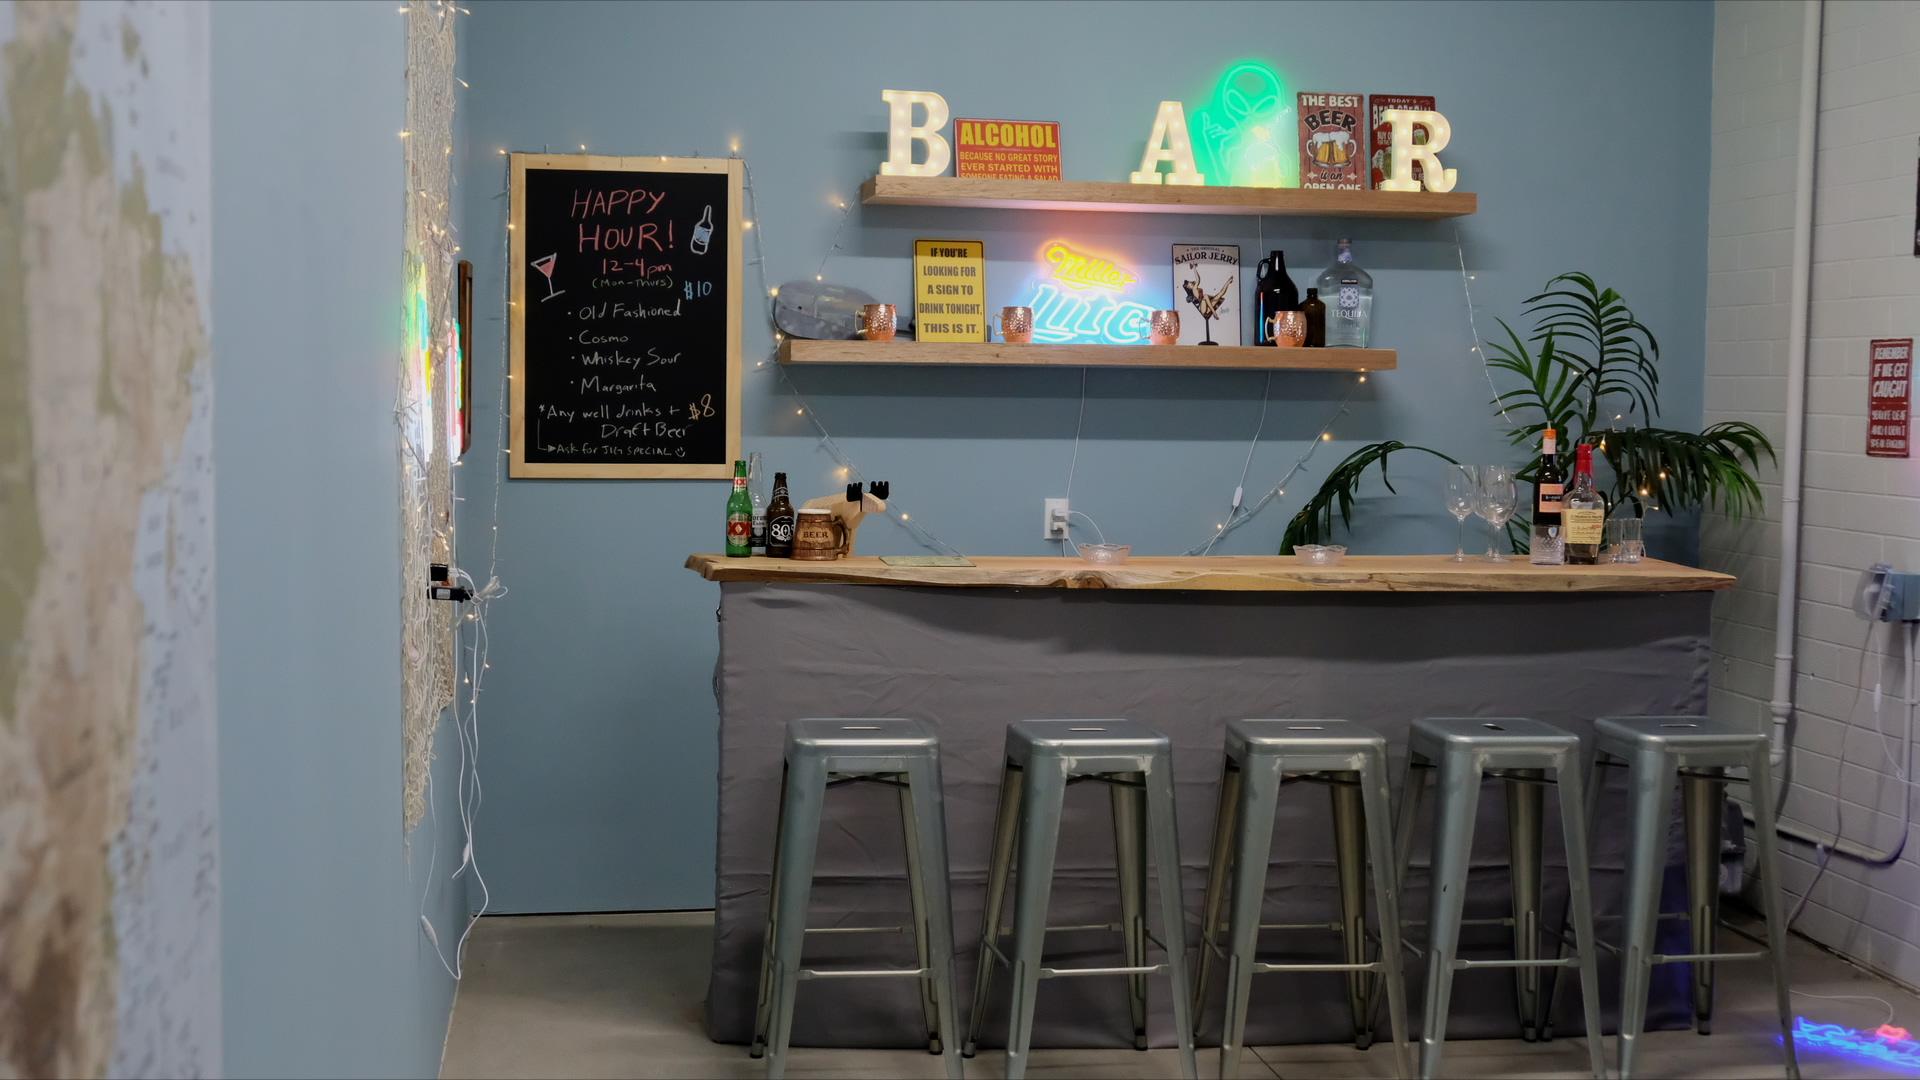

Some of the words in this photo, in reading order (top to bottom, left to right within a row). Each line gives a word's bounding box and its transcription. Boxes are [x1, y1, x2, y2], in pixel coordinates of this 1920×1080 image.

[1302, 95, 1326, 107] THE
[1328, 96, 1359, 108] BEST
[1303, 109, 1357, 132] BEER
[881, 89, 951, 177] B
[1130, 101, 1205, 187] A
[1379, 109, 1458, 193] R
[960, 122, 1057, 149] ALCOHOL
[960, 151, 993, 162] BECAUSE
[995, 153, 1006, 162] NO
[1008, 153, 1032, 163] GREAT
[1033, 154, 1058, 164] STORY
[961, 163, 984, 172] EVER
[987, 164, 1031, 173] STARTED
[1033, 165, 1058, 174] WITH
[1329, 172, 1344, 182] an
[571, 189, 665, 219] HAPPY
[579, 219, 673, 253] HOUR!
[930, 248, 938, 257] IF
[940, 248, 968, 258] YOU'RE
[1174, 251, 1207, 265] SAILOR
[1208, 251, 1238, 265] JERRY
[923, 265, 959, 277] LOOKING
[960, 266, 977, 277] FOR
[684, 280, 712, 300] $10
[927, 285, 935, 295] A
[936, 285, 959, 295] SIGN
[961, 285, 974, 296] TO
[579, 302, 607, 320] Old
[613, 298, 682, 318] Fashioned
[919, 303, 945, 314] DRINK
[946, 303, 983, 315] TONIGHT.
[1332, 309, 1368, 320] TEQUILA
[923, 323, 950, 333] THIS
[952, 324, 962, 333] IS
[966, 324, 980, 334] IT.
[578, 330, 629, 345] Cosmo
[581, 351, 641, 370] Whiskey
[647, 347, 682, 366] Sour
[581, 374, 657, 395] Margarita
[582, 404, 609, 419] well
[616, 402, 661, 419] drinks
[688, 393, 715, 421] $8
[601, 422, 651, 439] Draft
[655, 421, 688, 438] Beer
[556, 442, 577, 454] Ask
[582, 442, 597, 454] for
[626, 446, 673, 457] SPECIAL
[803, 531, 829, 539] BEER
